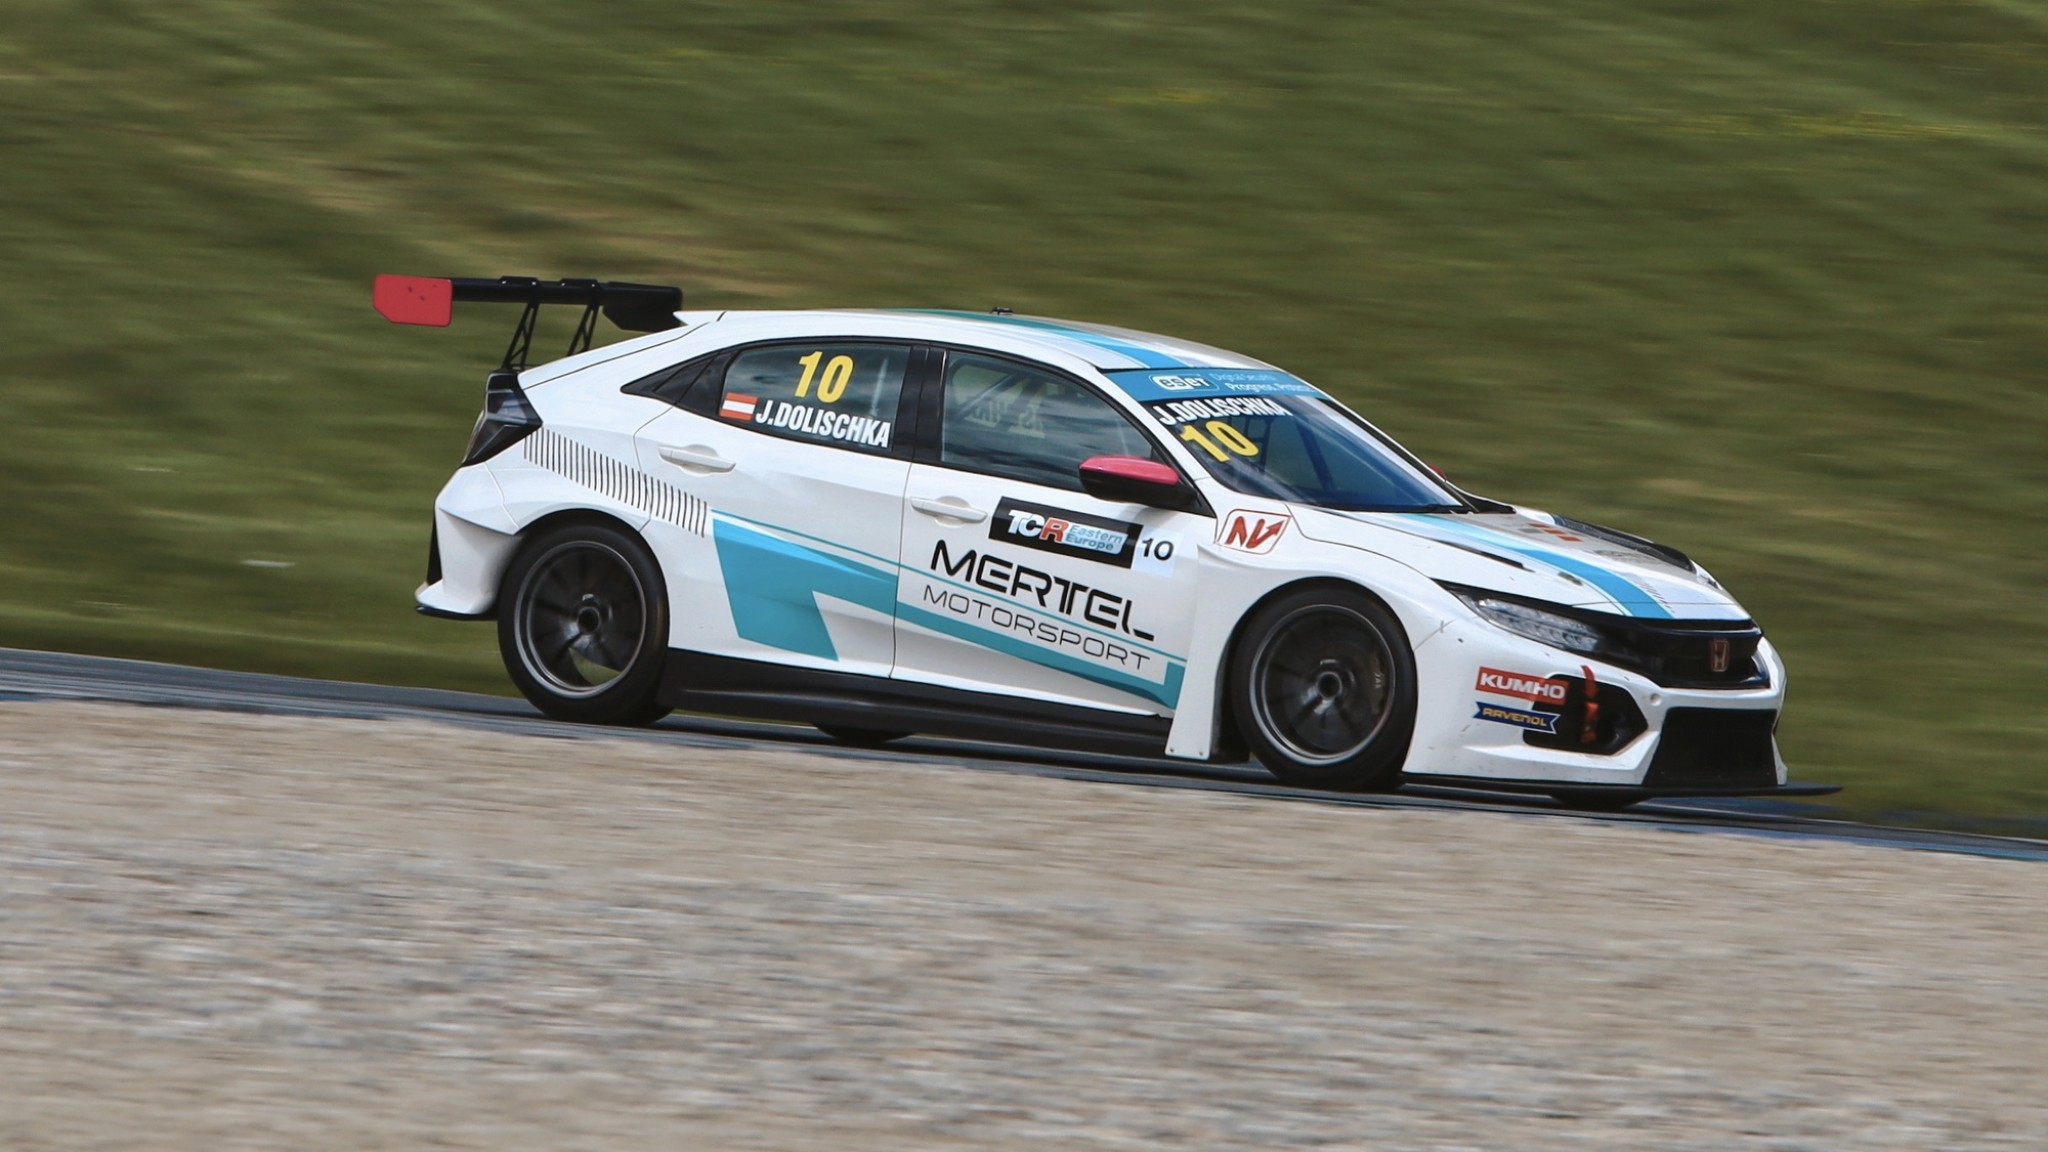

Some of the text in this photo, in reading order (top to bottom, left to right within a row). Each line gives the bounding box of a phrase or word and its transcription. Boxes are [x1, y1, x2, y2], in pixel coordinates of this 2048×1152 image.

[794, 350, 854, 403] 10
[755, 399, 892, 448] J.DOLISCHKA
[1153, 397, 1293, 426] J.DOLISCHKA
[1179, 420, 1259, 462] 10
[1007, 508, 1070, 543] TCR
[1069, 523, 1123, 544] Eastern
[1065, 533, 1115, 553] Europe
[1141, 537, 1175, 561] 10
[930, 539, 1155, 642] MERTEL
[923, 584, 1151, 670] MOTORSPORT
[1479, 672, 1566, 700] KUMHO
[1481, 707, 1548, 727] RAVENOL
